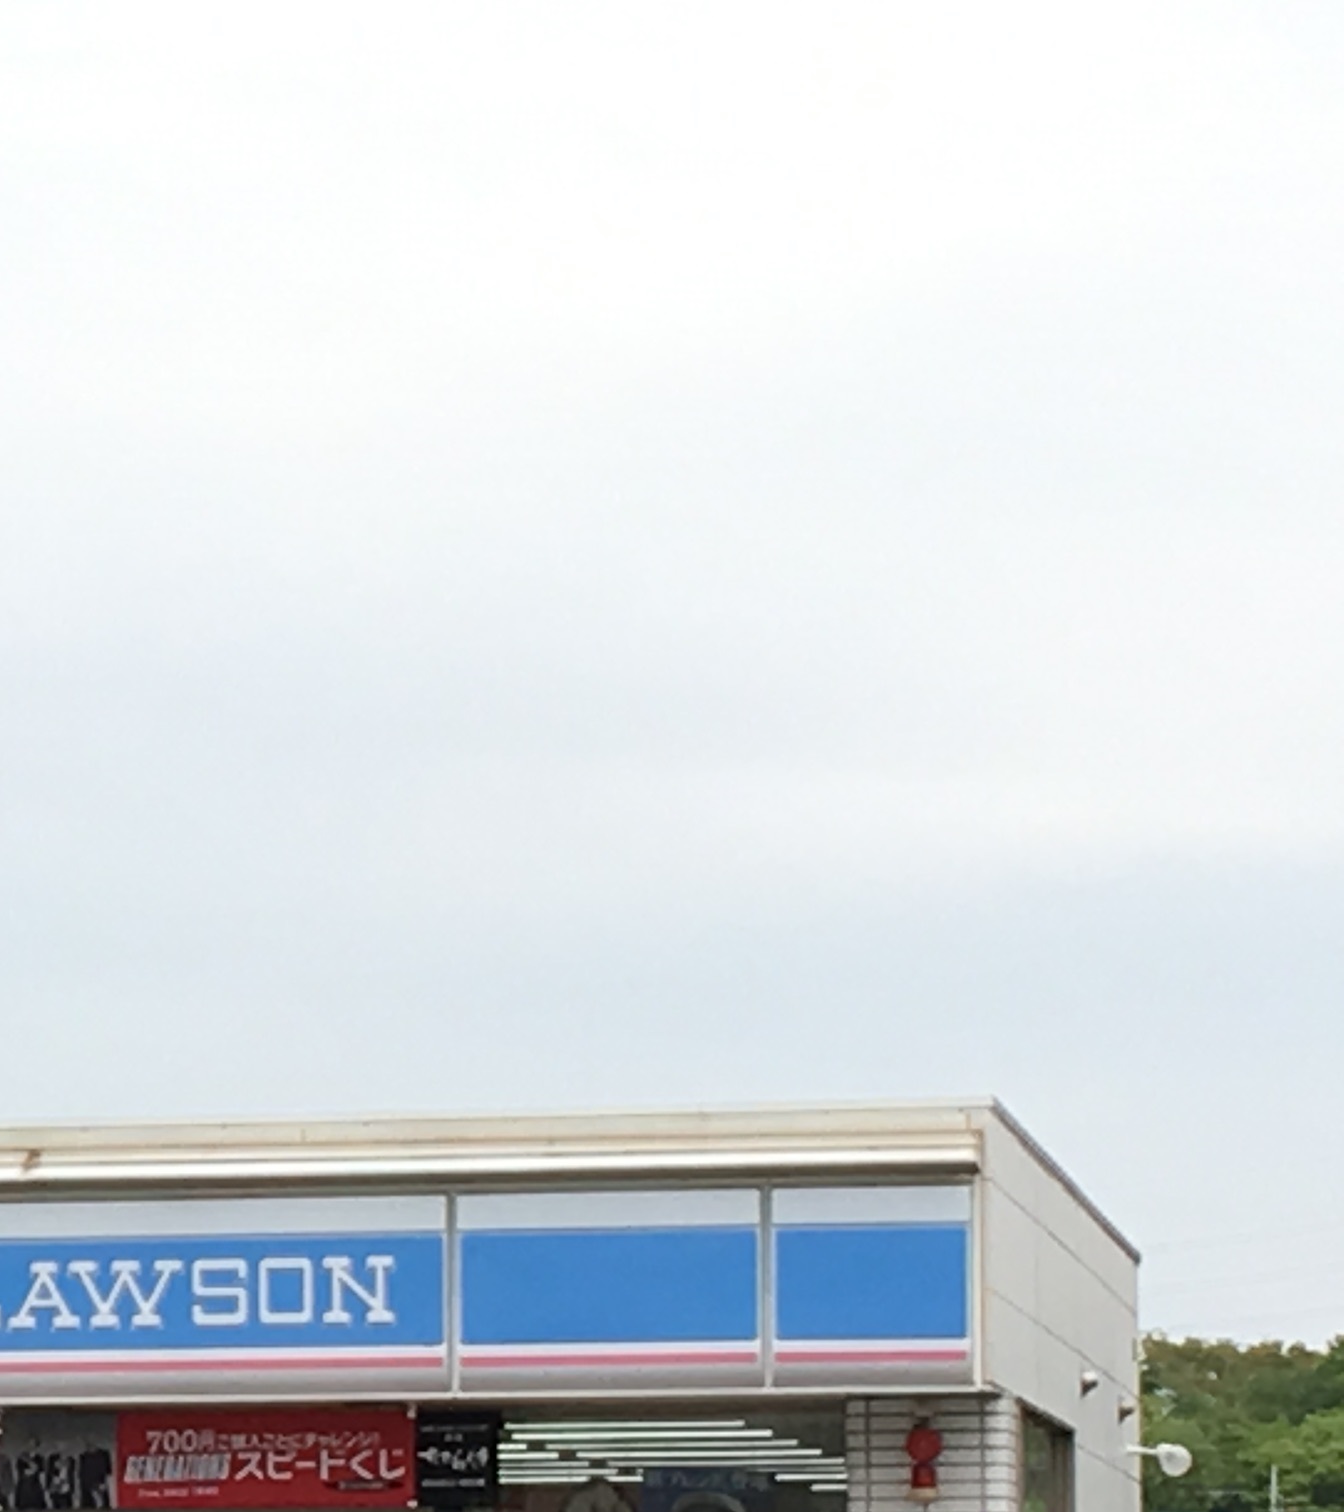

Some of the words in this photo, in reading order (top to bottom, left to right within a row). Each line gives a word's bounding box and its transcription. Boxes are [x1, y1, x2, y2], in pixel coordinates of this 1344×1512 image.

[234, 1449, 407, 1481] スピードくじ
